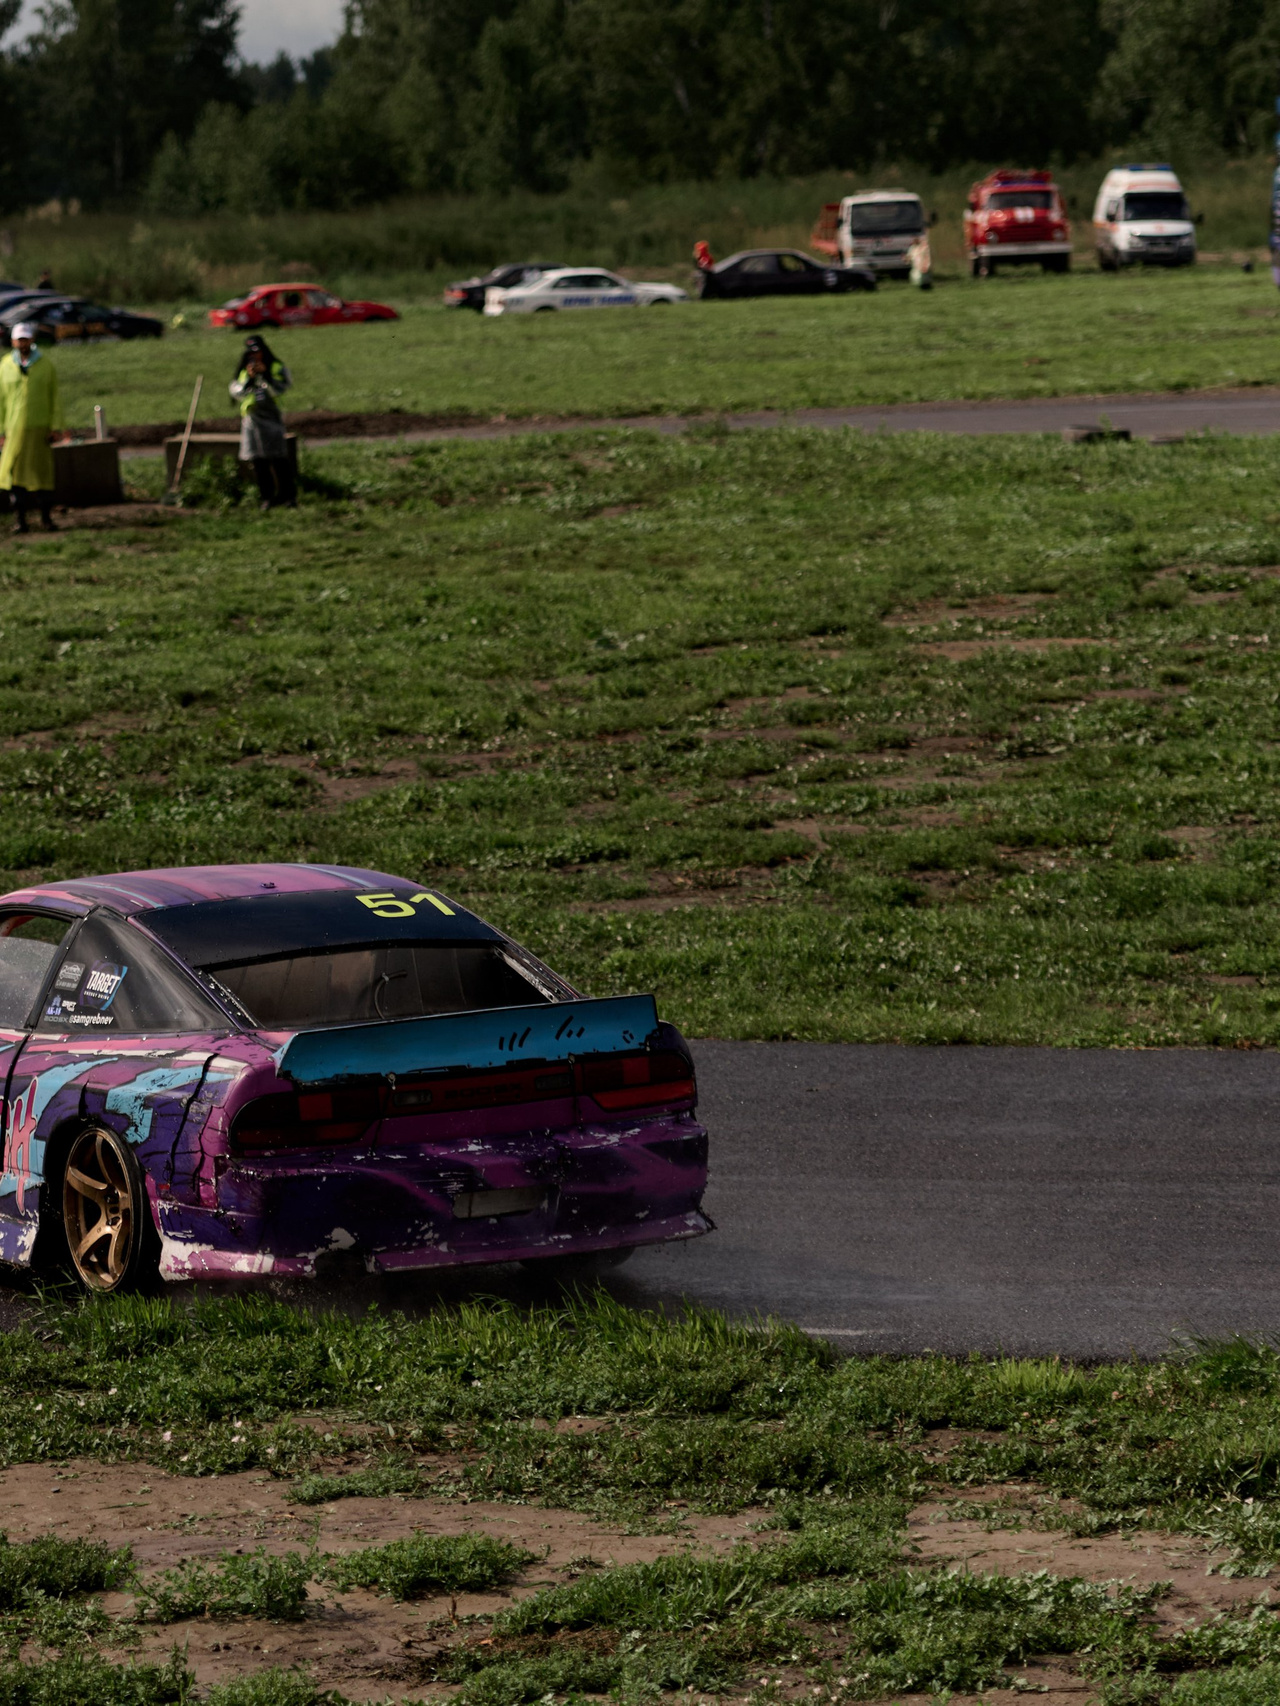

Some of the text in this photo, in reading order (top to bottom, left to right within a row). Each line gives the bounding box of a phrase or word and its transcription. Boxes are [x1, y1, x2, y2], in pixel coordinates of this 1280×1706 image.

[355, 893, 456, 918] 51
[86, 970, 121, 994] TARGET
[69, 1013, 114, 1026] @samgrebnev
